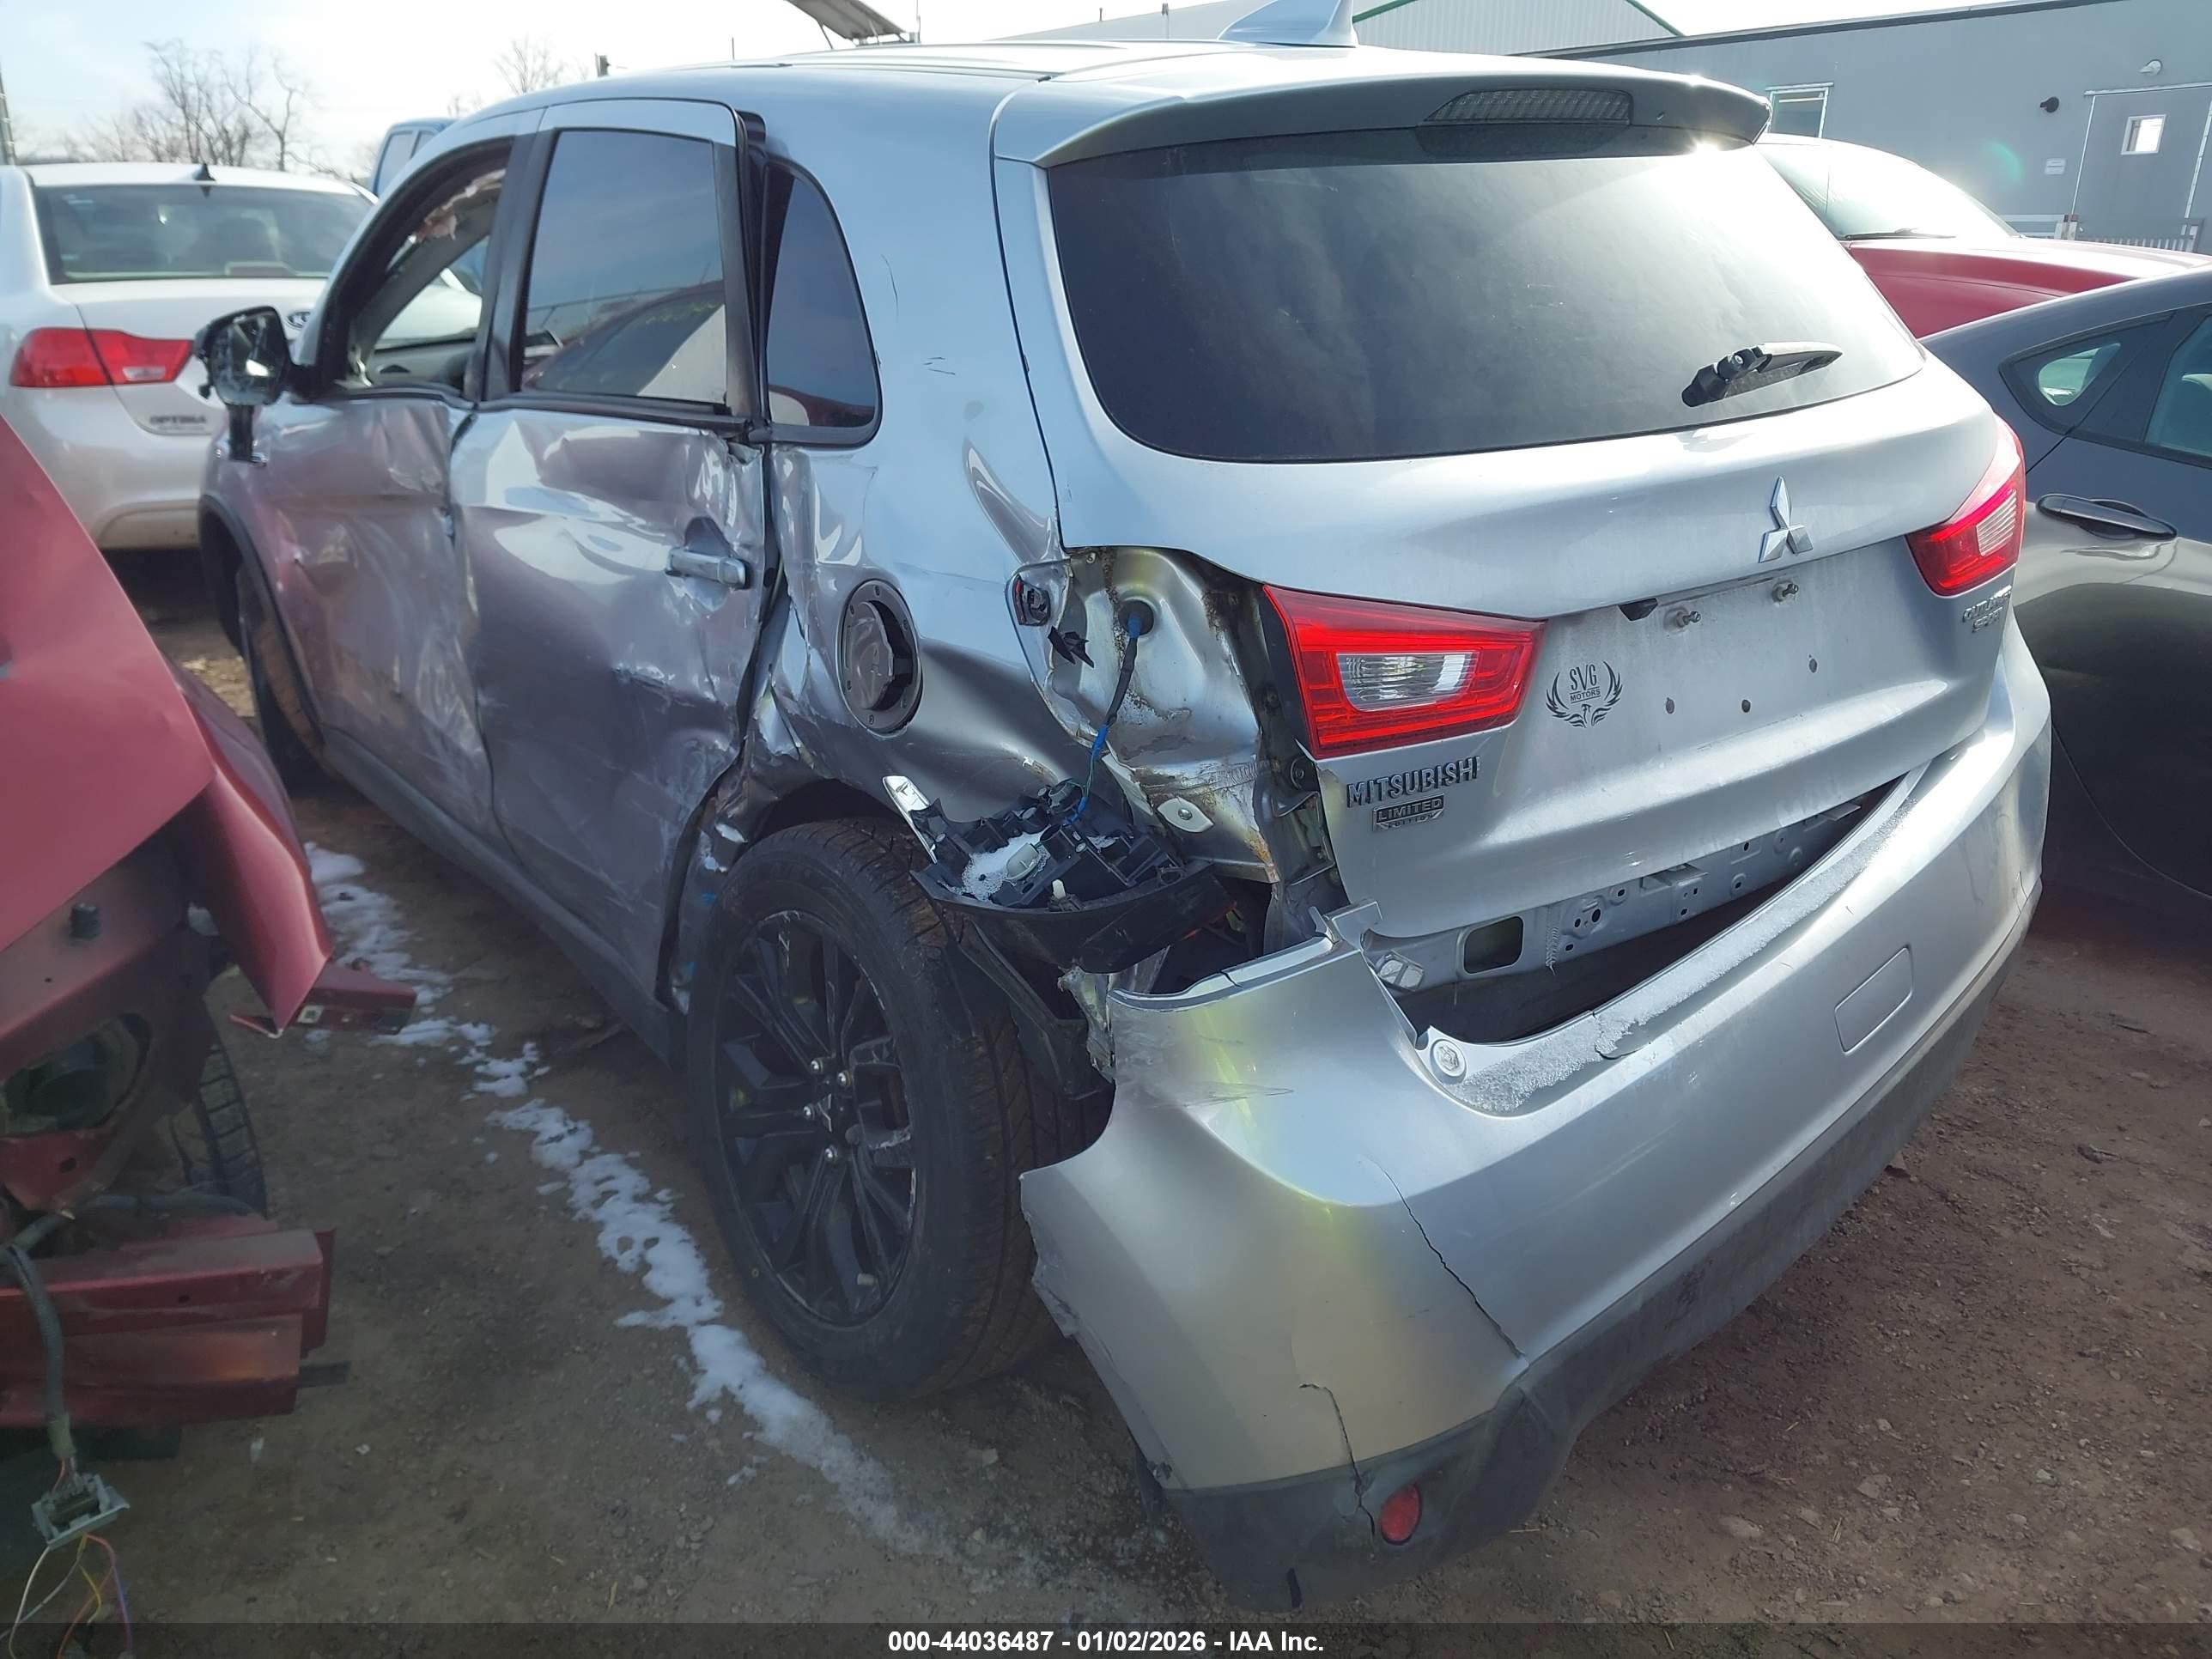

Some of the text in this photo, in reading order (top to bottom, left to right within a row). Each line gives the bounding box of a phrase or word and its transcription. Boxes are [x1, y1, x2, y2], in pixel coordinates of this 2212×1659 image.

[1569, 664, 1597, 691] SVG
[1570, 688, 1601, 702] MOTORS
[1346, 755, 1480, 808] MITSUBISHI
[1378, 798, 1443, 822] LIMITED
